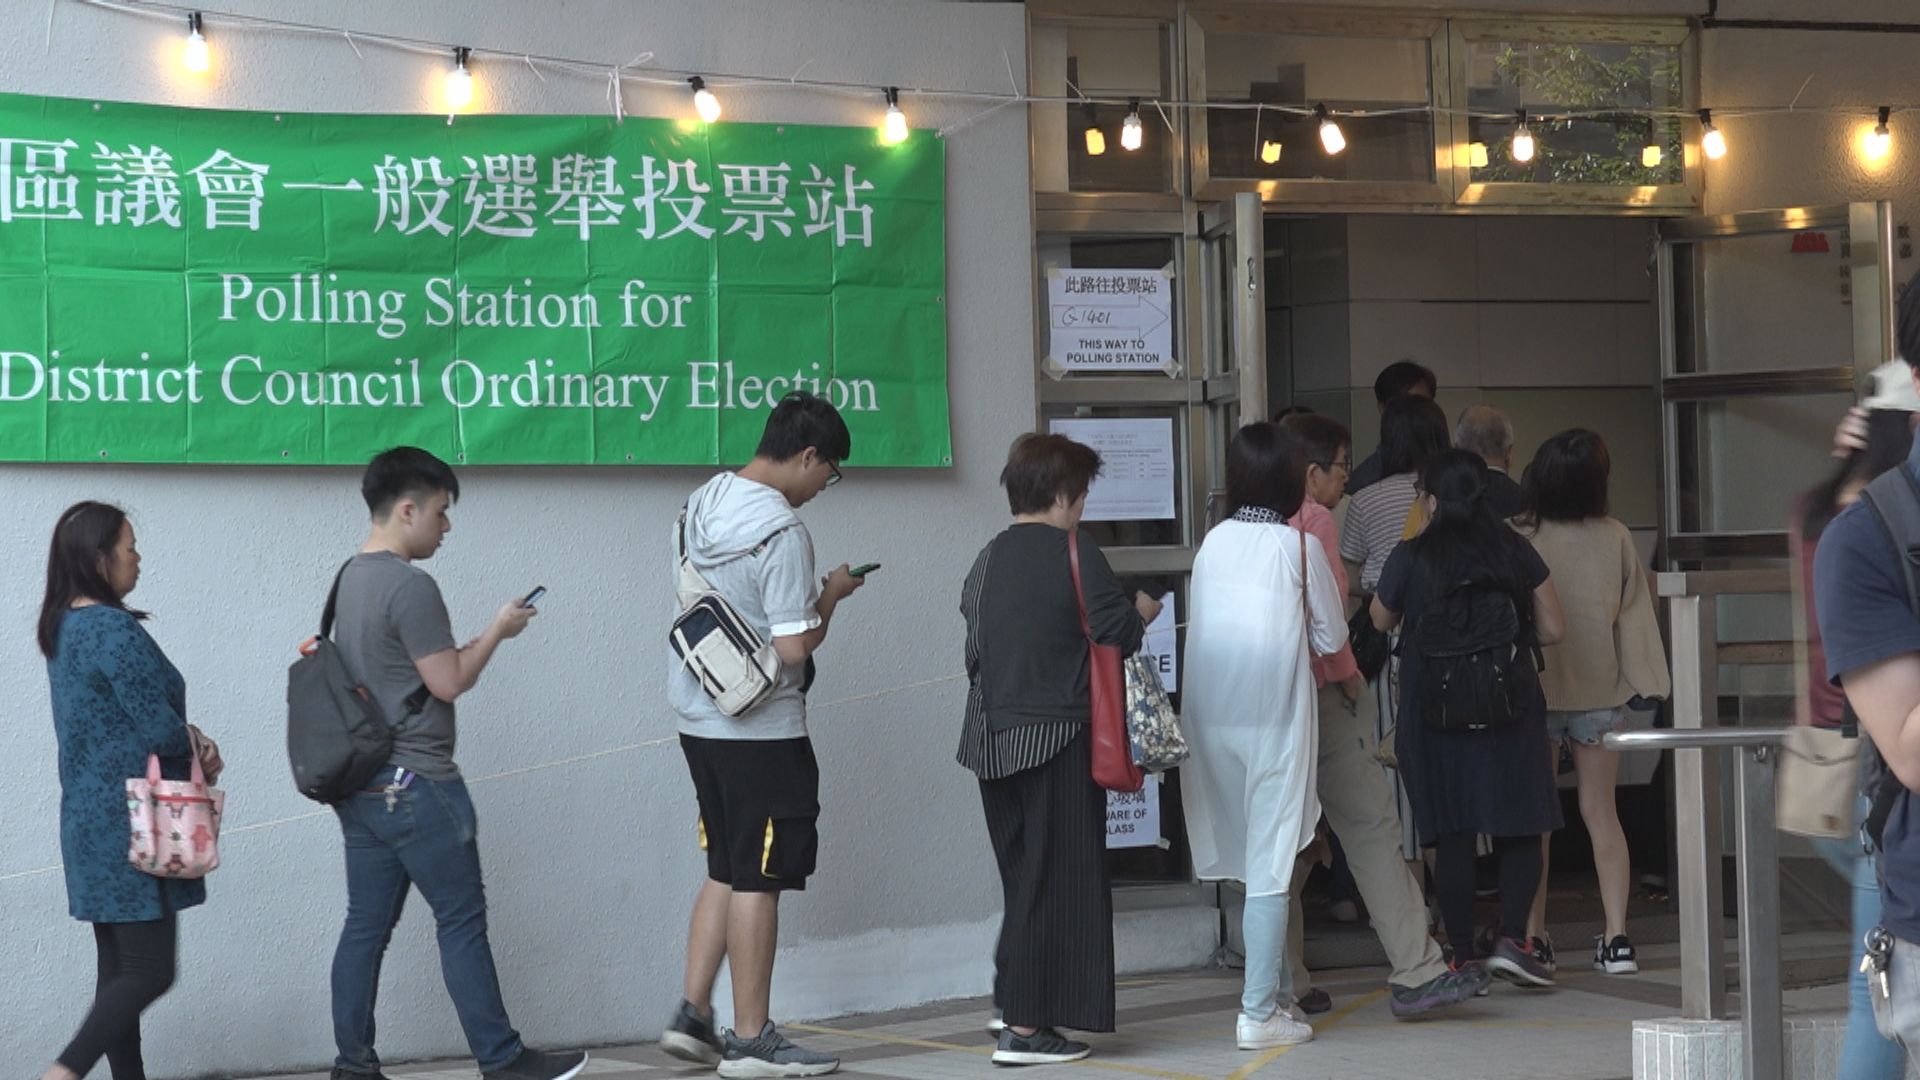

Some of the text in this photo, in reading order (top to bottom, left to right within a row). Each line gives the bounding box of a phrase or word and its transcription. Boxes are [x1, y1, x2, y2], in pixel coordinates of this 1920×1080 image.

[0, 137, 875, 248] 區議會一般選舉投票站
[1064, 276, 1157, 295] 此路往投票站
[217, 273, 692, 339] Polling Station for
[1079, 339, 1145, 350] THIS WAY TO
[1066, 353, 1160, 364] POLLING STATION
[0, 350, 880, 421] District Council Ordinary Election
[1133, 808, 1148, 819] OF
